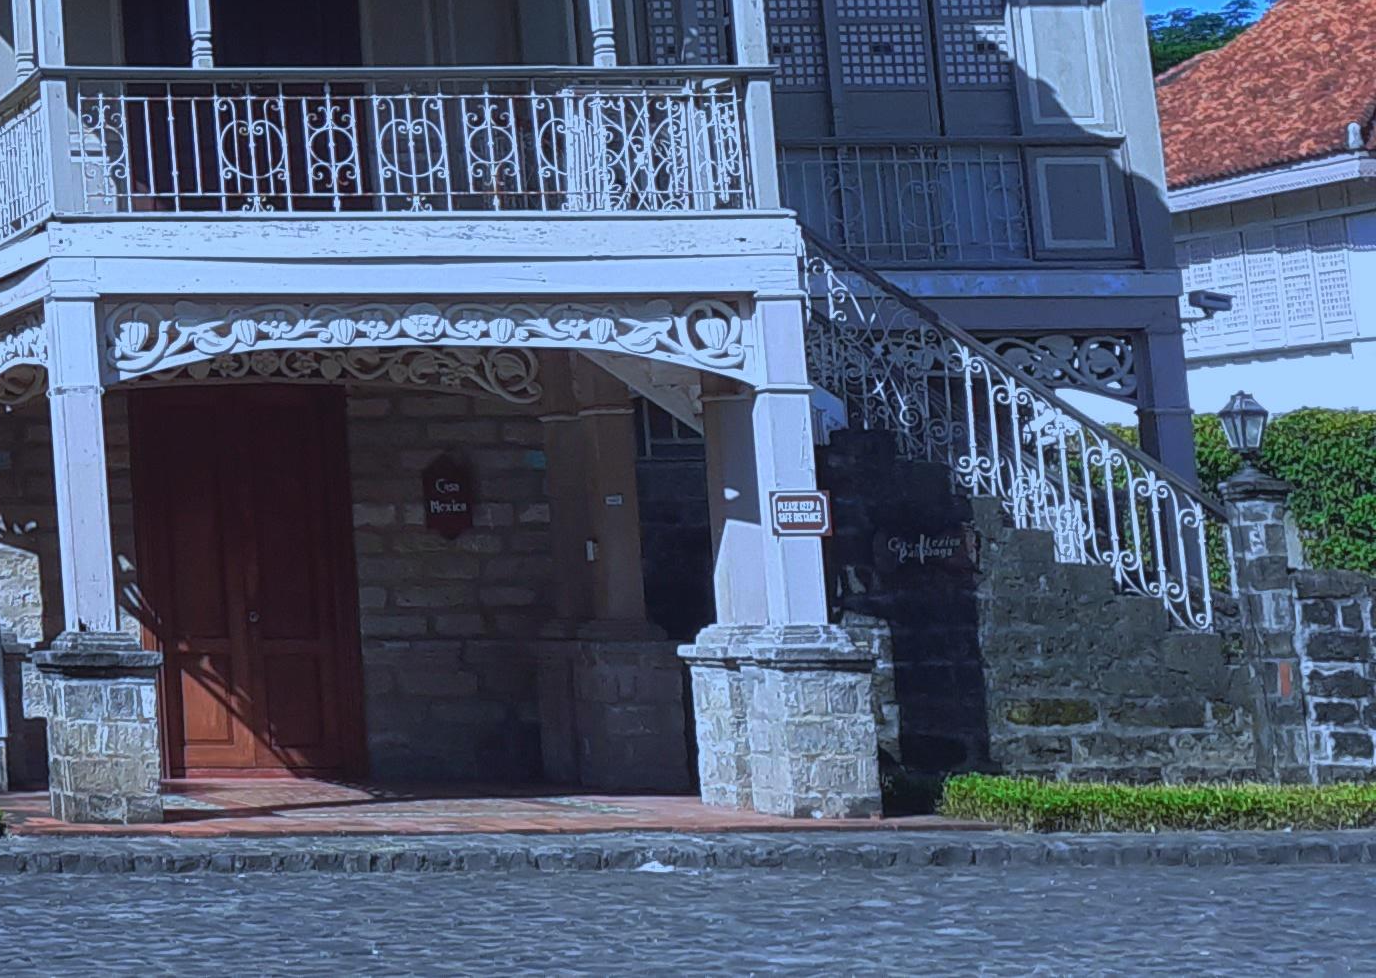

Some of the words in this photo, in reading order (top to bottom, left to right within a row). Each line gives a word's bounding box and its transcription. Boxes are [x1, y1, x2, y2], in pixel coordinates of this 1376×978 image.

[435, 478, 460, 494] Casa
[430, 499, 466, 514] Mexico
[778, 501, 799, 512] PLEASE
[799, 500, 815, 512] KEEP
[816, 500, 822, 511] A
[778, 513, 794, 523] SAFE
[794, 513, 822, 523] DISTANCE
